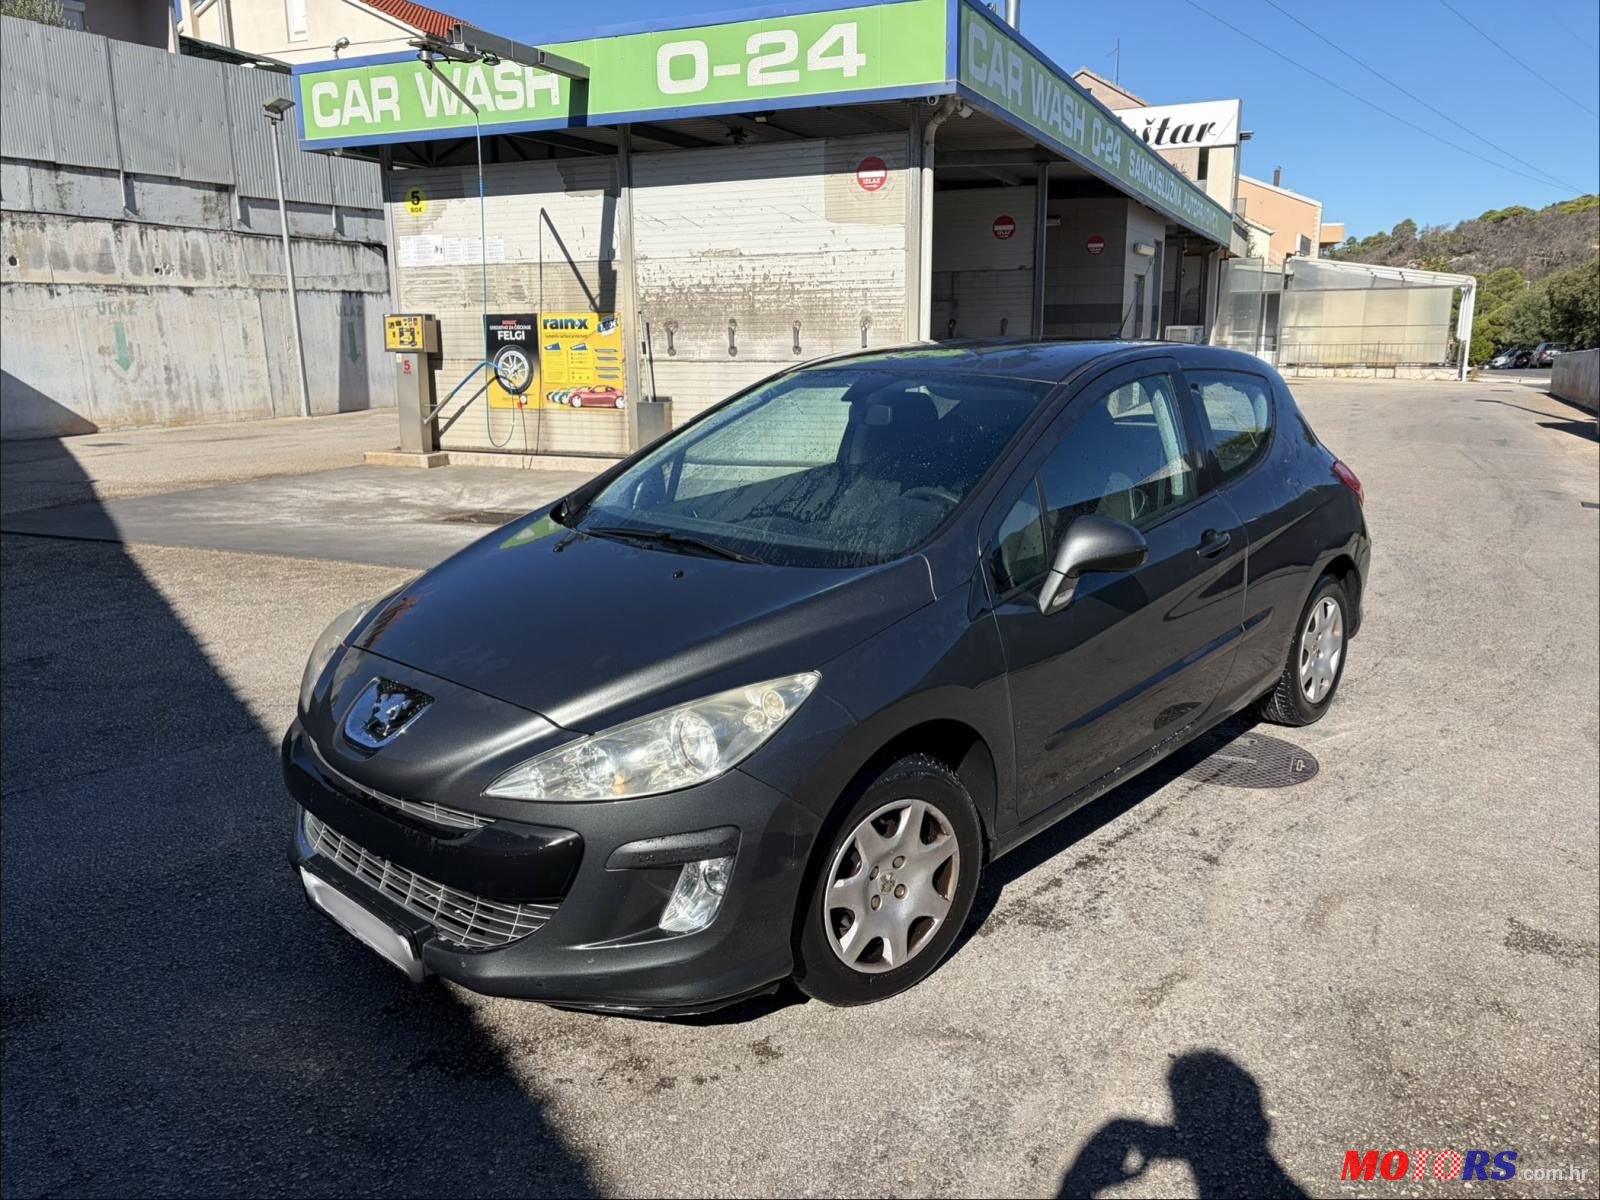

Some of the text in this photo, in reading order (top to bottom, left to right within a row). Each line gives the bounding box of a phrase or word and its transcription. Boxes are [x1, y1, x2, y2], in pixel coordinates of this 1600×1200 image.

[311, 22, 867, 128] CAR WASH 0-24
[968, 22, 1024, 107] CAR
[1031, 66, 1086, 146] WASH
[1092, 116, 1121, 169] 0-24
[411, 190, 420, 206] 5
[497, 331, 526, 341] FELGI
[403, 359, 411, 371] 5
